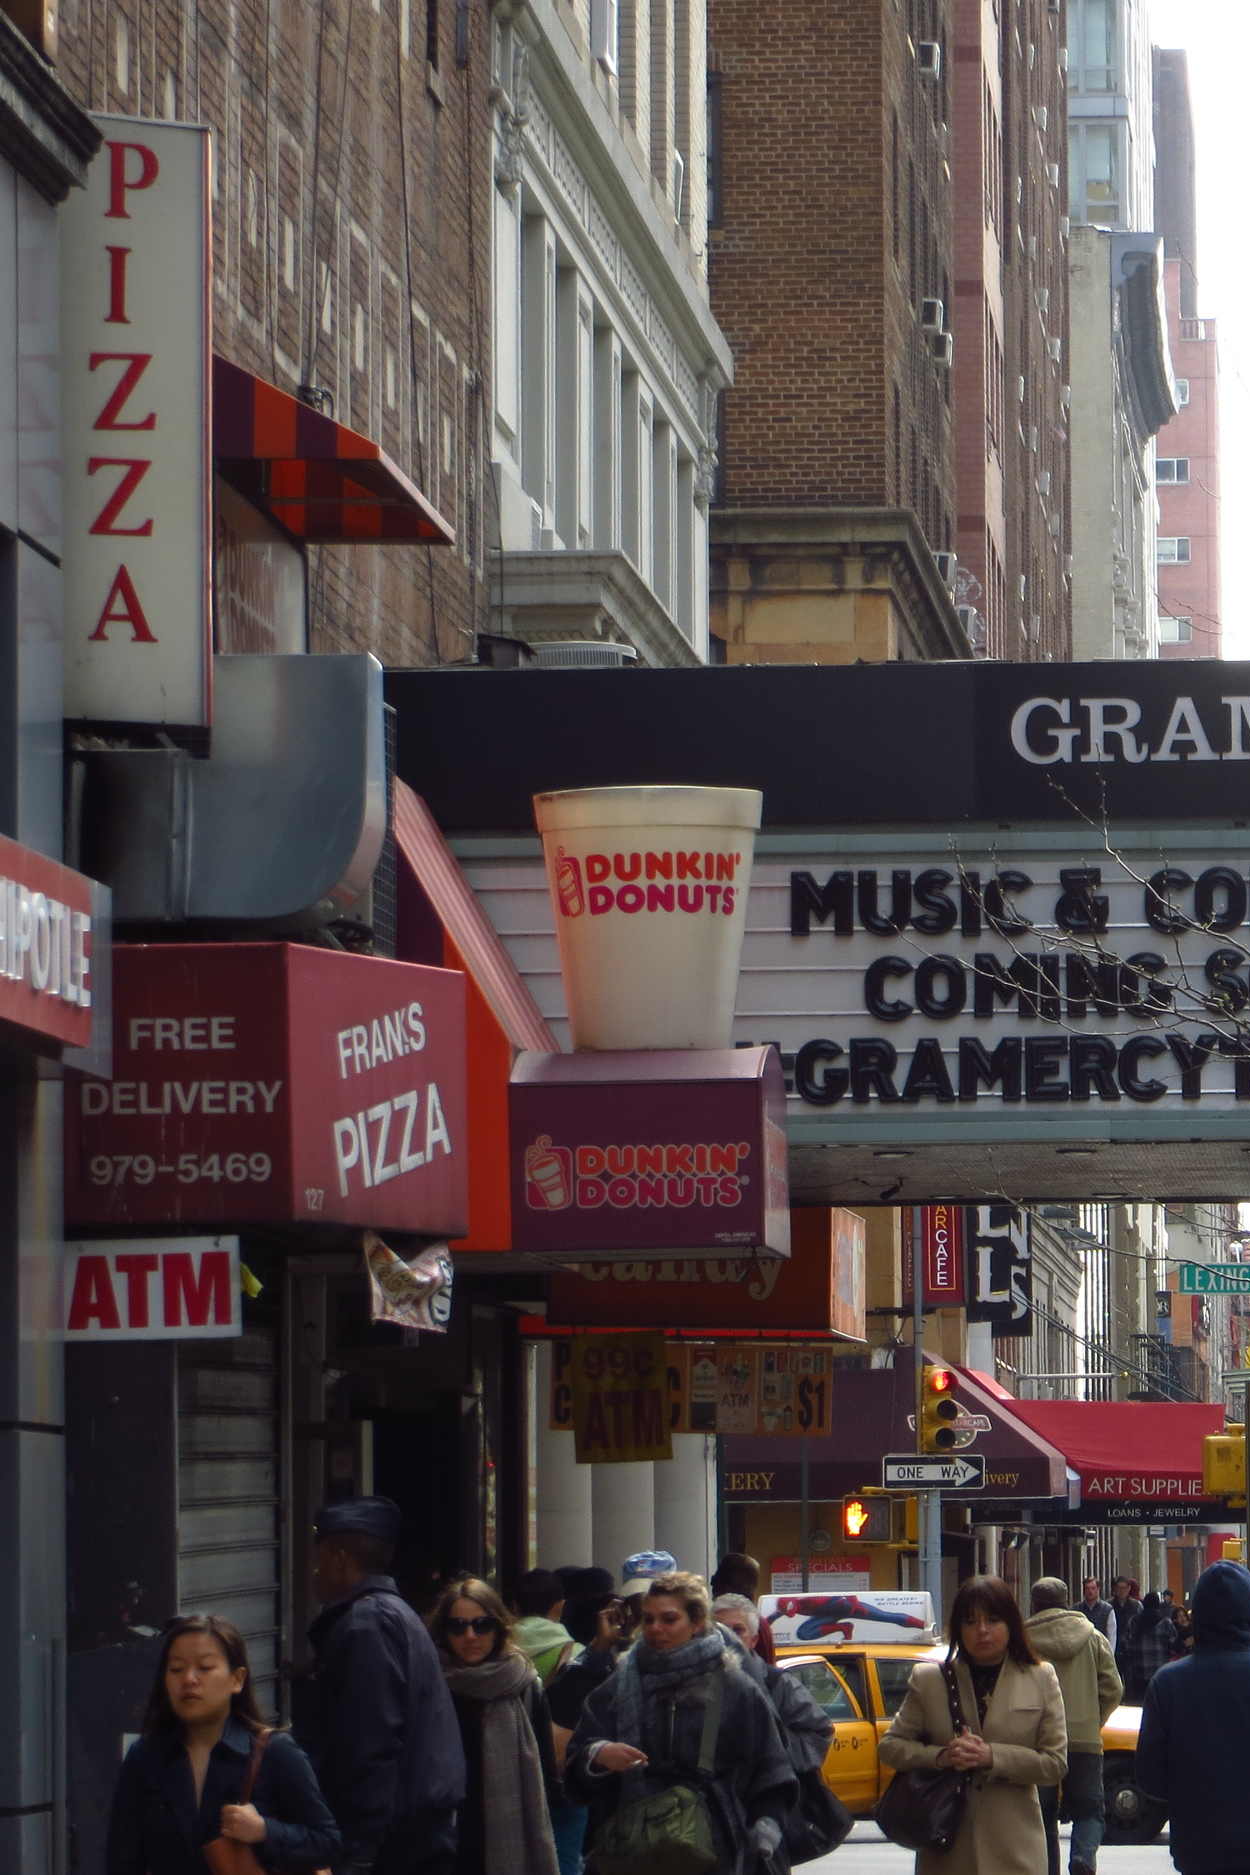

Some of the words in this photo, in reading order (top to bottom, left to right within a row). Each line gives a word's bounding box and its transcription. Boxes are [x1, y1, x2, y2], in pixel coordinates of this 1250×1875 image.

[88, 141, 158, 643] PIZZA
[586, 851, 741, 884] DUNKIN'
[589, 884, 737, 916] DONUTS
[790, 869, 1035, 938] MUSIC
[1055, 867, 1110, 936] &
[864, 950, 1173, 1022] COMING
[130, 1017, 236, 1051] FREE
[81, 1080, 284, 1116] DELIVERY
[333, 1082, 453, 1198] PIZZA
[89, 1153, 273, 1185] 979-5469
[576, 1142, 751, 1177] DUNKIN'
[304, 1187, 325, 1212] 127
[577, 1174, 743, 1210] DONUTS
[67, 1250, 233, 1331] ATM
[582, 1388, 665, 1450] ATM
[798, 1375, 826, 1433] $1
[896, 1466, 924, 1479] ONE
[940, 1466, 970, 1479] WAY
[1088, 1477, 1127, 1495] ART
[1130, 1477, 1207, 1496] SUPPLIE
[1107, 1508, 1141, 1518] LOANS
[1152, 1507, 1200, 1518] JEWELRY
